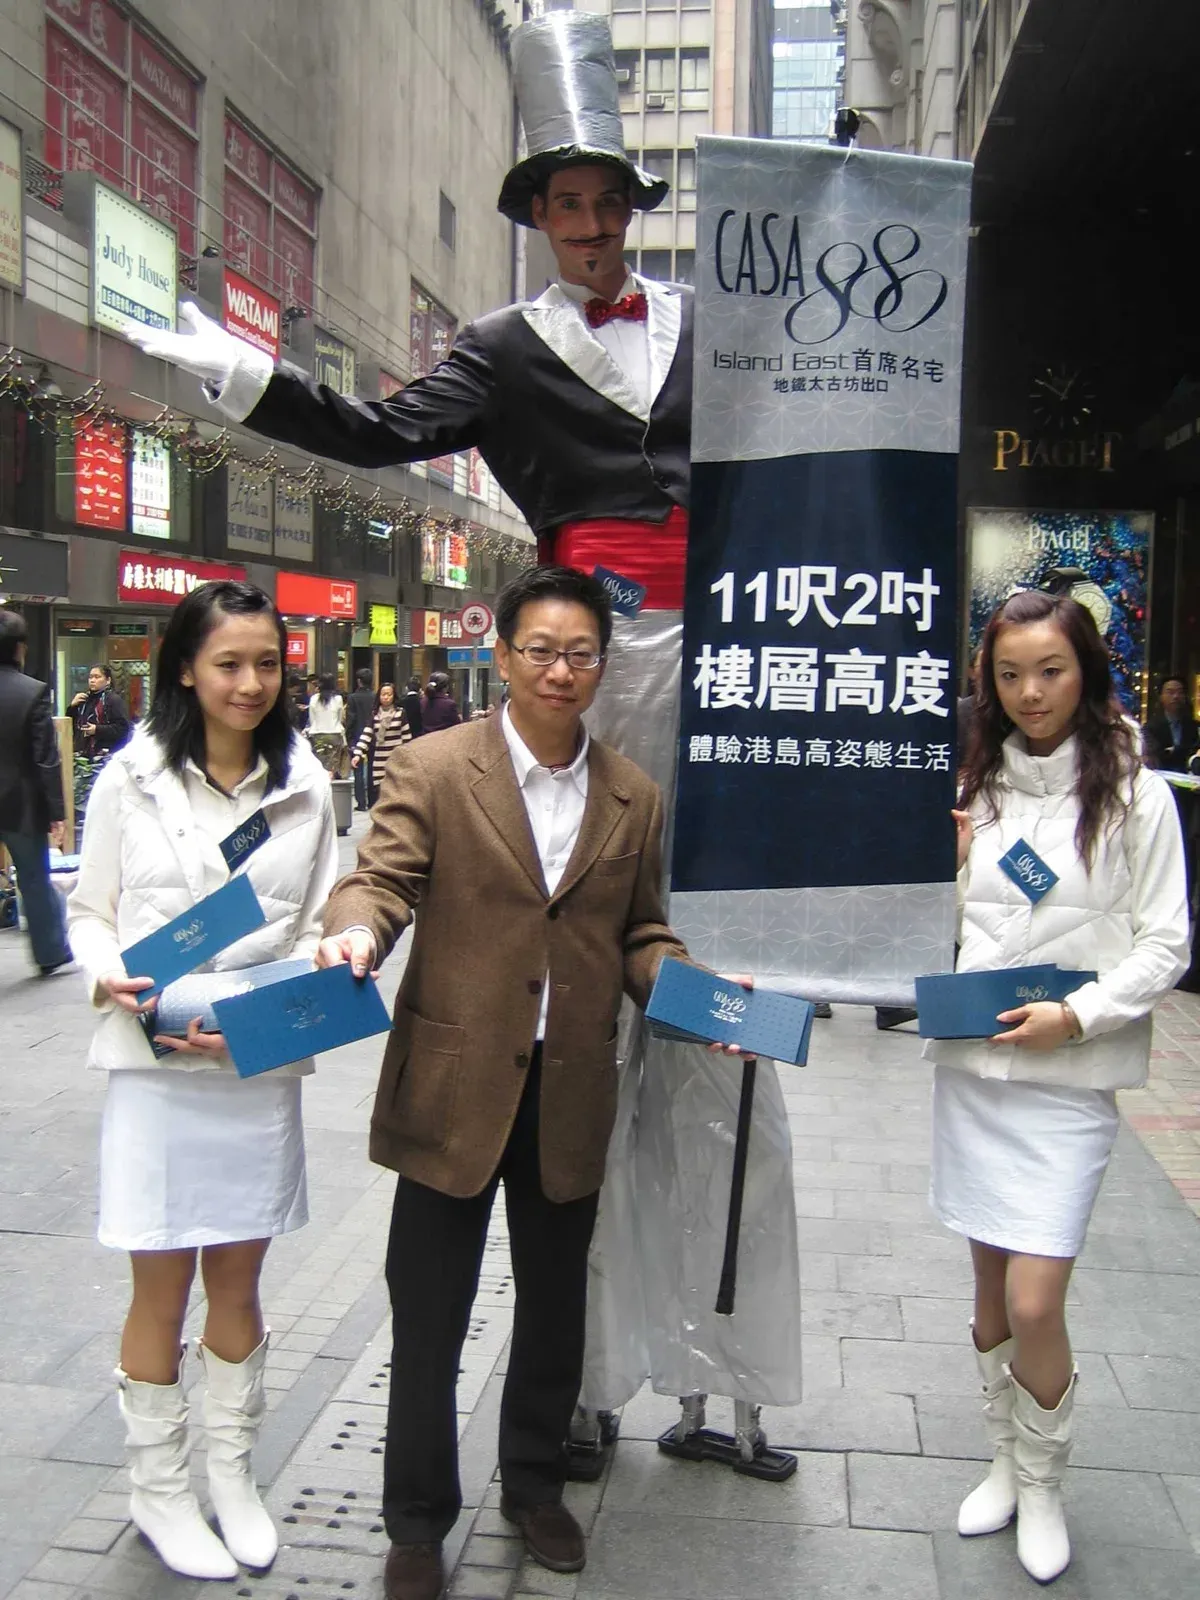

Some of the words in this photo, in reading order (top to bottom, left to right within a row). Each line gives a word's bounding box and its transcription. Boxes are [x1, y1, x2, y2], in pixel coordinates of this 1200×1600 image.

[139, 50, 187, 111] WATAMI
[102, 234, 133, 280] Judy
[138, 254, 170, 293] House
[716, 209, 805, 297] CASA
[226, 282, 279, 339] WATAMI
[713, 349, 783, 372] Island
[793, 352, 849, 372] East
[852, 348, 944, 383] 首席名宅
[773, 375, 889, 393] 地鐵太古坊出口
[992, 430, 1122, 472] PIAGET
[1028, 522, 1095, 553] PIAGET
[710, 565, 941, 632] 11呎2吋
[693, 644, 950, 718] 樓層高度
[688, 734, 952, 772] 體驗港島高姿態生活
